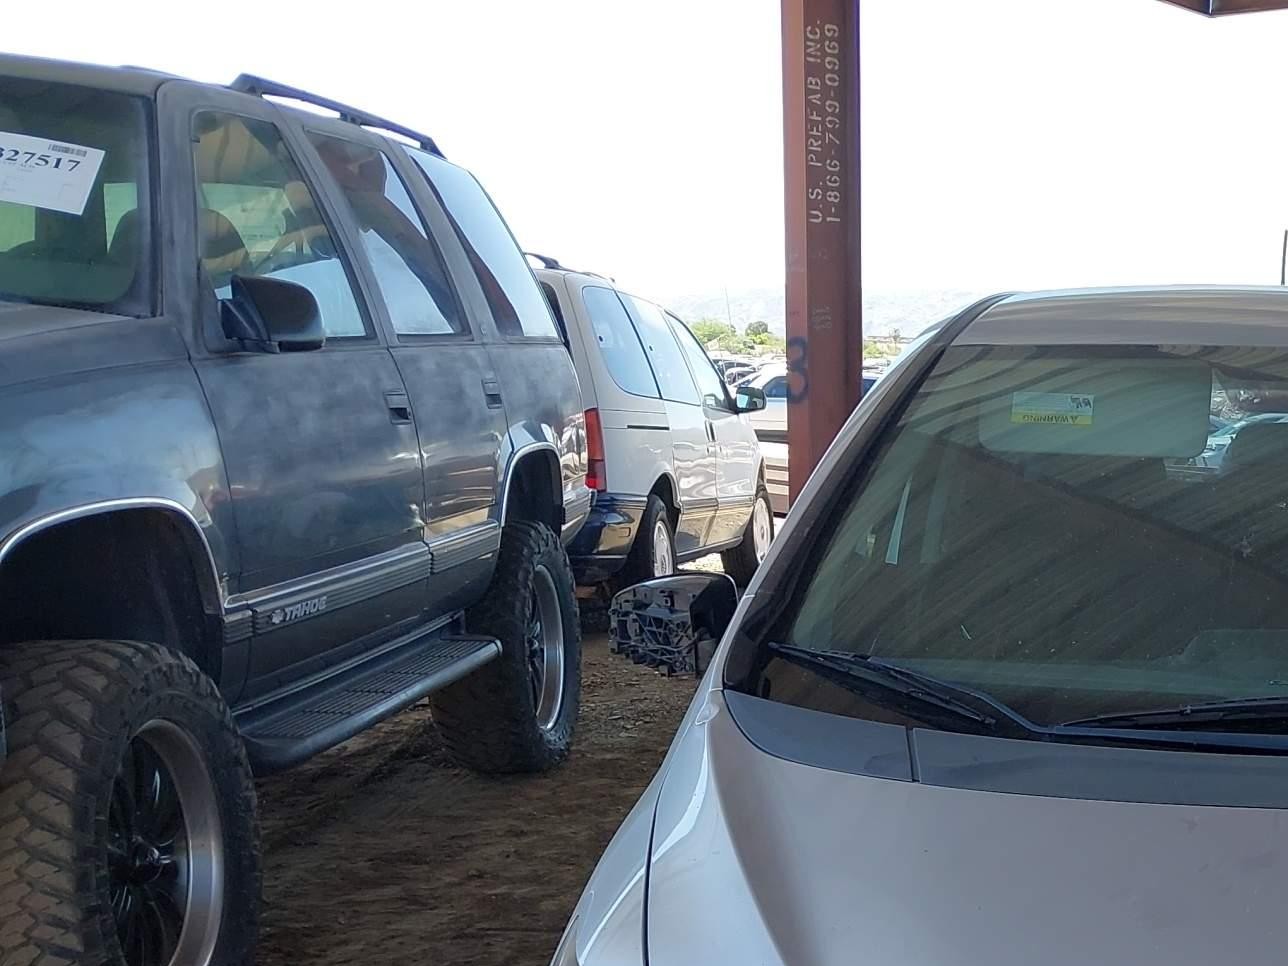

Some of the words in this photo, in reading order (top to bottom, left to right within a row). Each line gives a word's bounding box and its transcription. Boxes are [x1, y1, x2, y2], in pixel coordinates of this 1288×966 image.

[805, 20, 821, 63] INC.
[807, 76, 823, 167] PREFAB
[824, 23, 841, 223] 1-866-799-0969
[808, 181, 823, 223] U.S.
[285, 596, 327, 621] TAHOE
